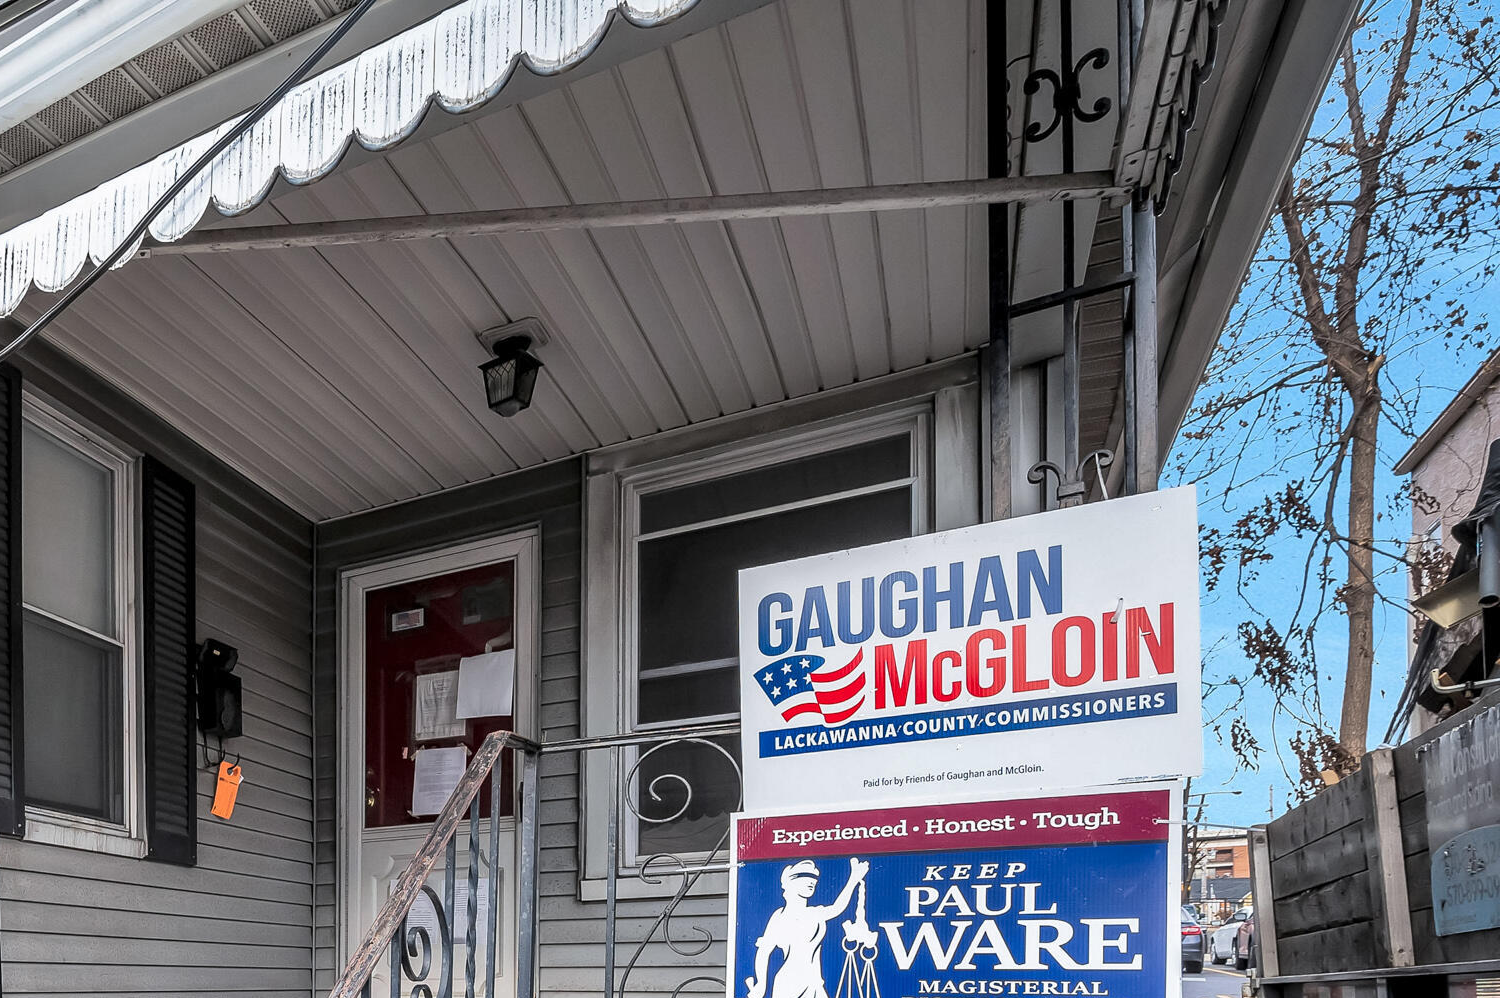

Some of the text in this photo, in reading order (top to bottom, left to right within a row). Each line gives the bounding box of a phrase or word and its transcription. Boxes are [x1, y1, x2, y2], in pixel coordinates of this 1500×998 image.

[758, 545, 1063, 656] GAUGHAN
[874, 602, 1175, 711] McGLOIN
[774, 692, 1165, 751] LACKAWANNA COUNTY COMMISSIONERS
[863, 764, 1045, 788] Paid for by Friends of Gaughan and McGloin.
[772, 806, 1120, 847] Experienced Honest Tough
[922, 862, 1027, 881] KEEP
[904, 882, 1058, 917] PAUL
[879, 917, 1143, 971] WARE
[918, 979, 1108, 996] MAGISTERIAL
